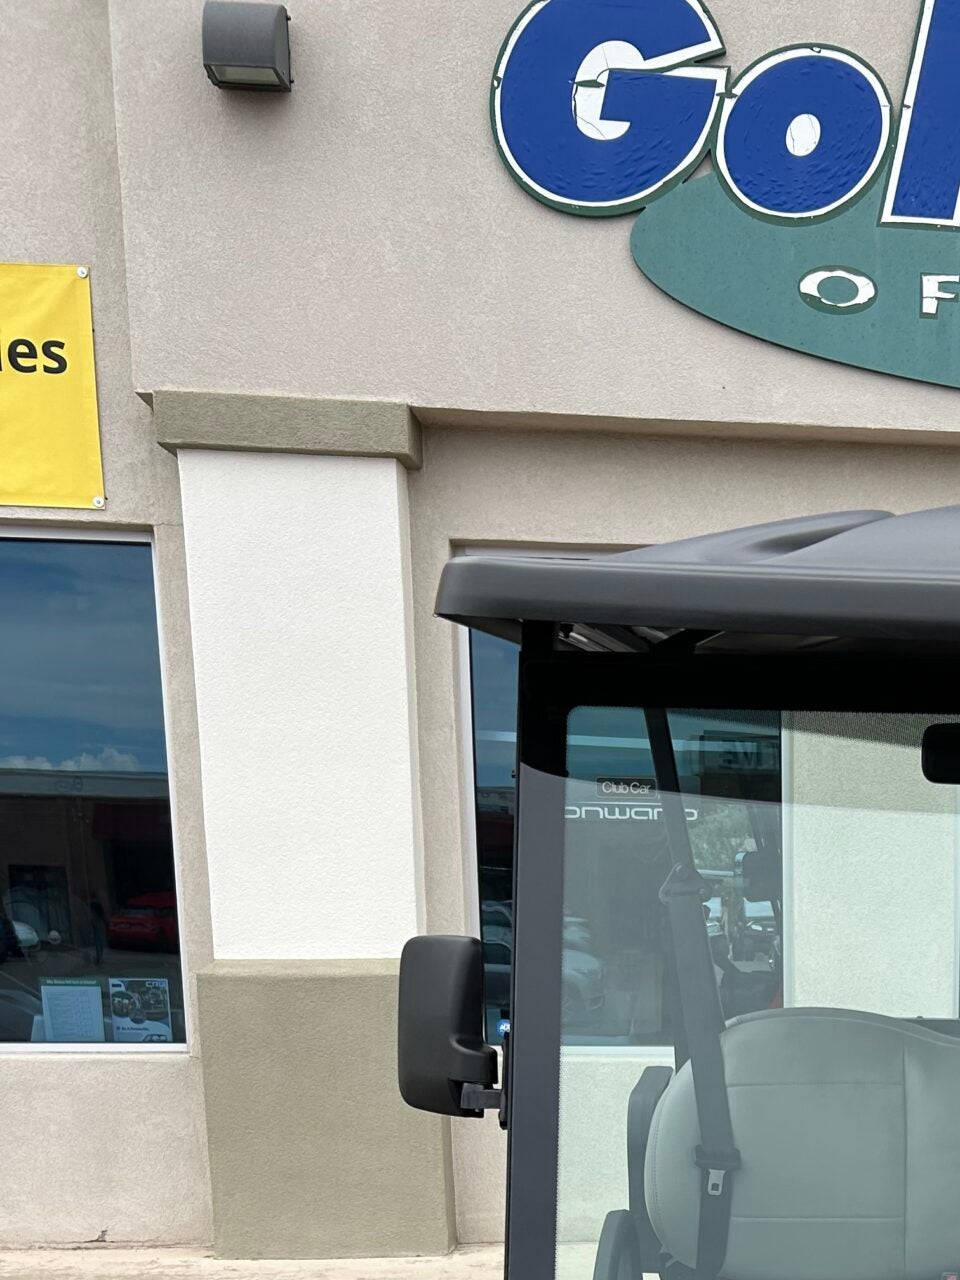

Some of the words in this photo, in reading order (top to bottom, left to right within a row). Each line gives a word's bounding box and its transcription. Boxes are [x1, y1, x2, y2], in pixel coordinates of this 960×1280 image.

[800, 269, 960, 316] OF
[0, 338, 67, 374] es
[602, 780, 629, 794] Club
[629, 781, 652, 794] Car
